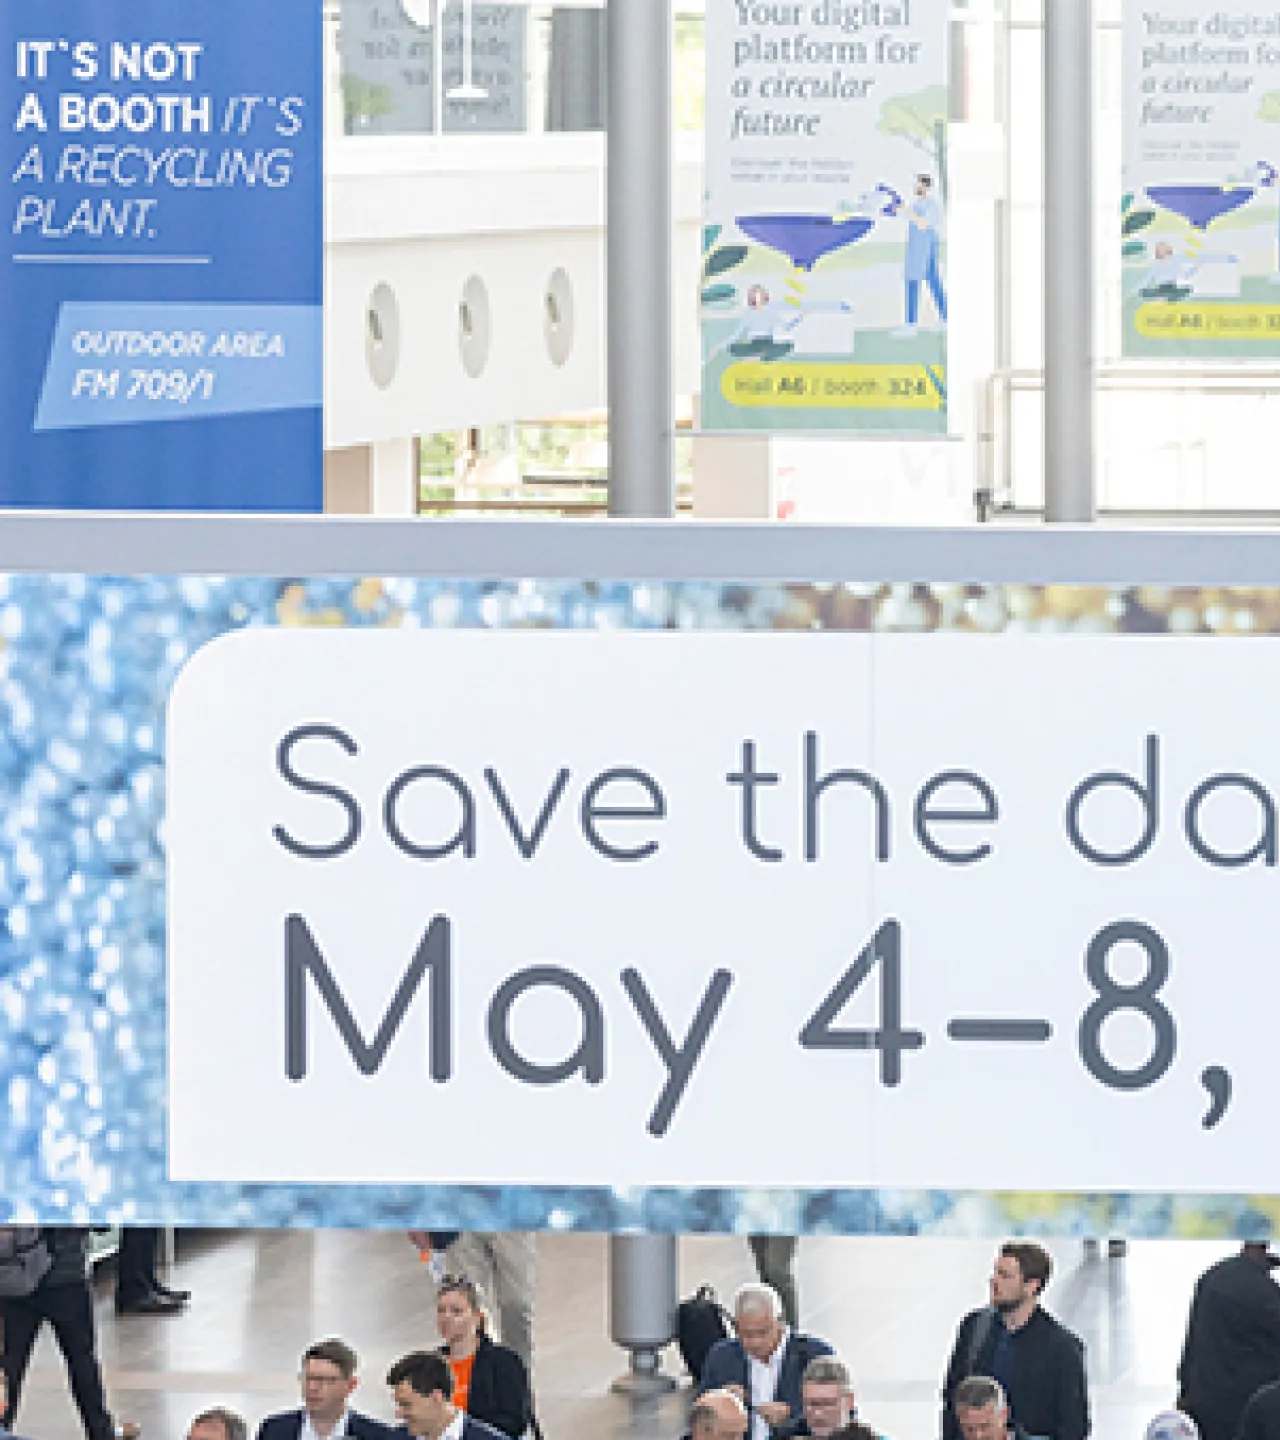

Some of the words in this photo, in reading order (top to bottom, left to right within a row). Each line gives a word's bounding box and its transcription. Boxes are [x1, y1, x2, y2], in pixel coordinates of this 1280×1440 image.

[734, 0, 801, 25] Your
[811, 0, 909, 30] digital
[111, 42, 202, 80] NOT
[734, 33, 867, 66] platform
[876, 33, 919, 63] for
[731, 78, 750, 98] a
[759, 71, 874, 98] circular
[16, 93, 47, 130] A
[60, 94, 210, 132] BOOTH
[731, 106, 820, 140] future
[12, 145, 43, 182] A
[56, 145, 293, 187] RECYCLING
[13, 196, 157, 237] PLANT.
[73, 331, 206, 357] OUTDOOR
[210, 332, 284, 357] AREA
[72, 369, 120, 397] FM
[127, 369, 214, 403] 709/1
[272, 725, 666, 862] Save
[726, 731, 999, 864] the
[284, 913, 733, 1138] May
